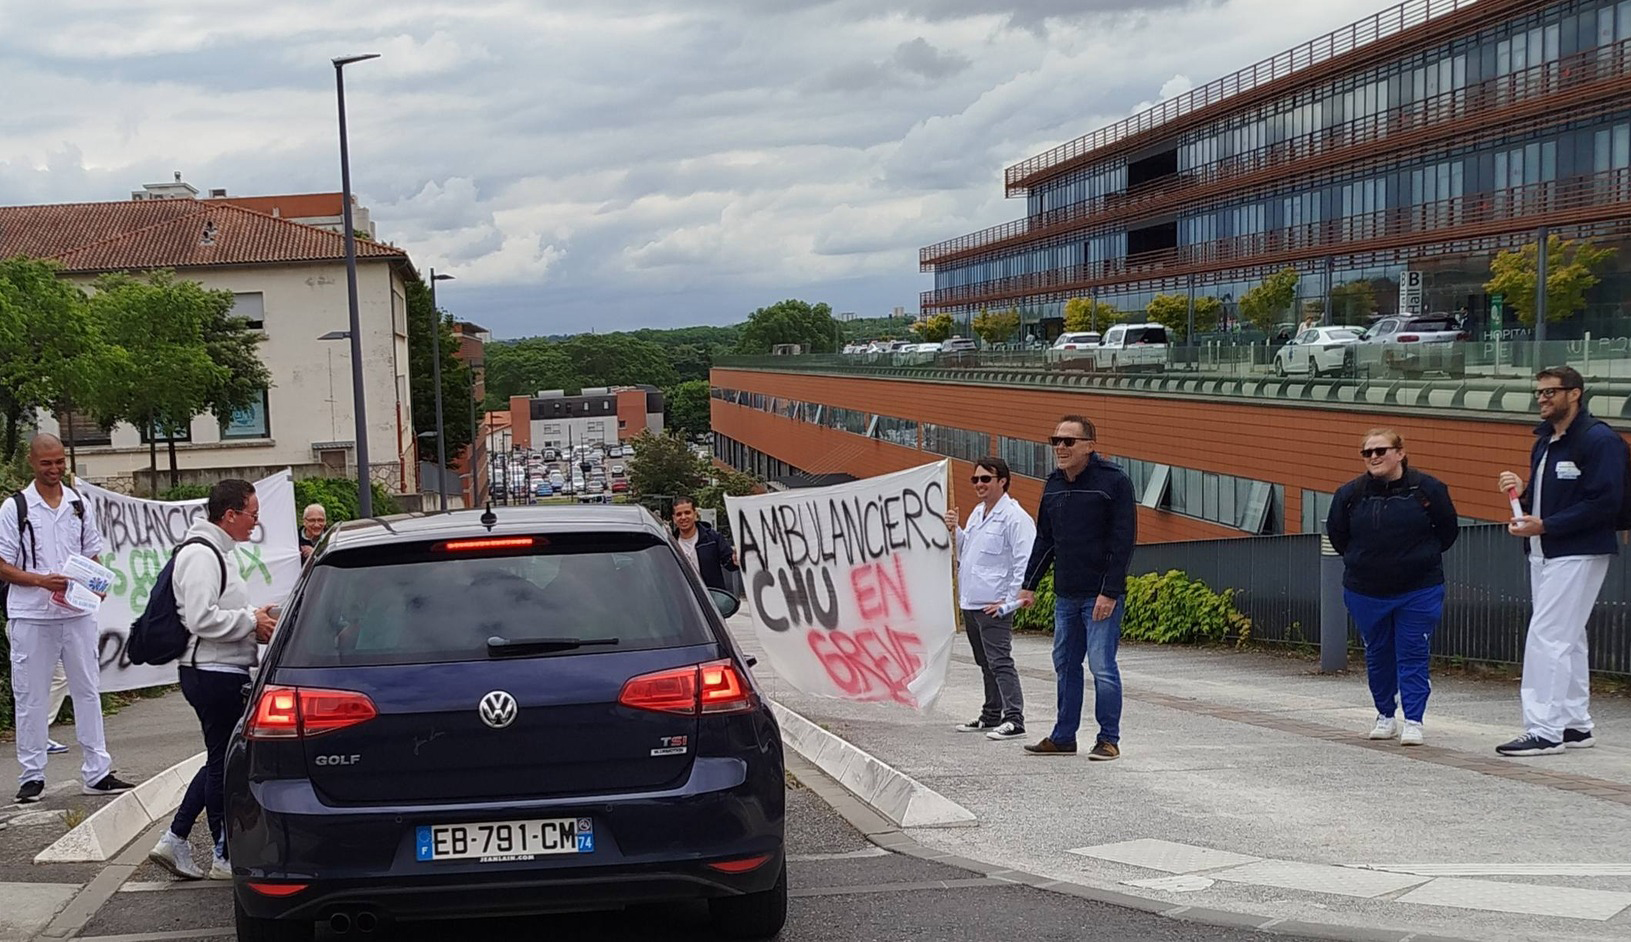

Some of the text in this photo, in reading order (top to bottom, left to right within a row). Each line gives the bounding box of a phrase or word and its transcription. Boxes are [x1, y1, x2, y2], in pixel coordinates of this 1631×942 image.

[1409, 271, 1420, 287] B
[1407, 289, 1420, 314] Hall
[752, 552, 913, 632] CHU EN
[660, 735, 688, 747] TSI
[315, 754, 361, 766] GOLF
[421, 821, 592, 856] F EB-791-CM 74
